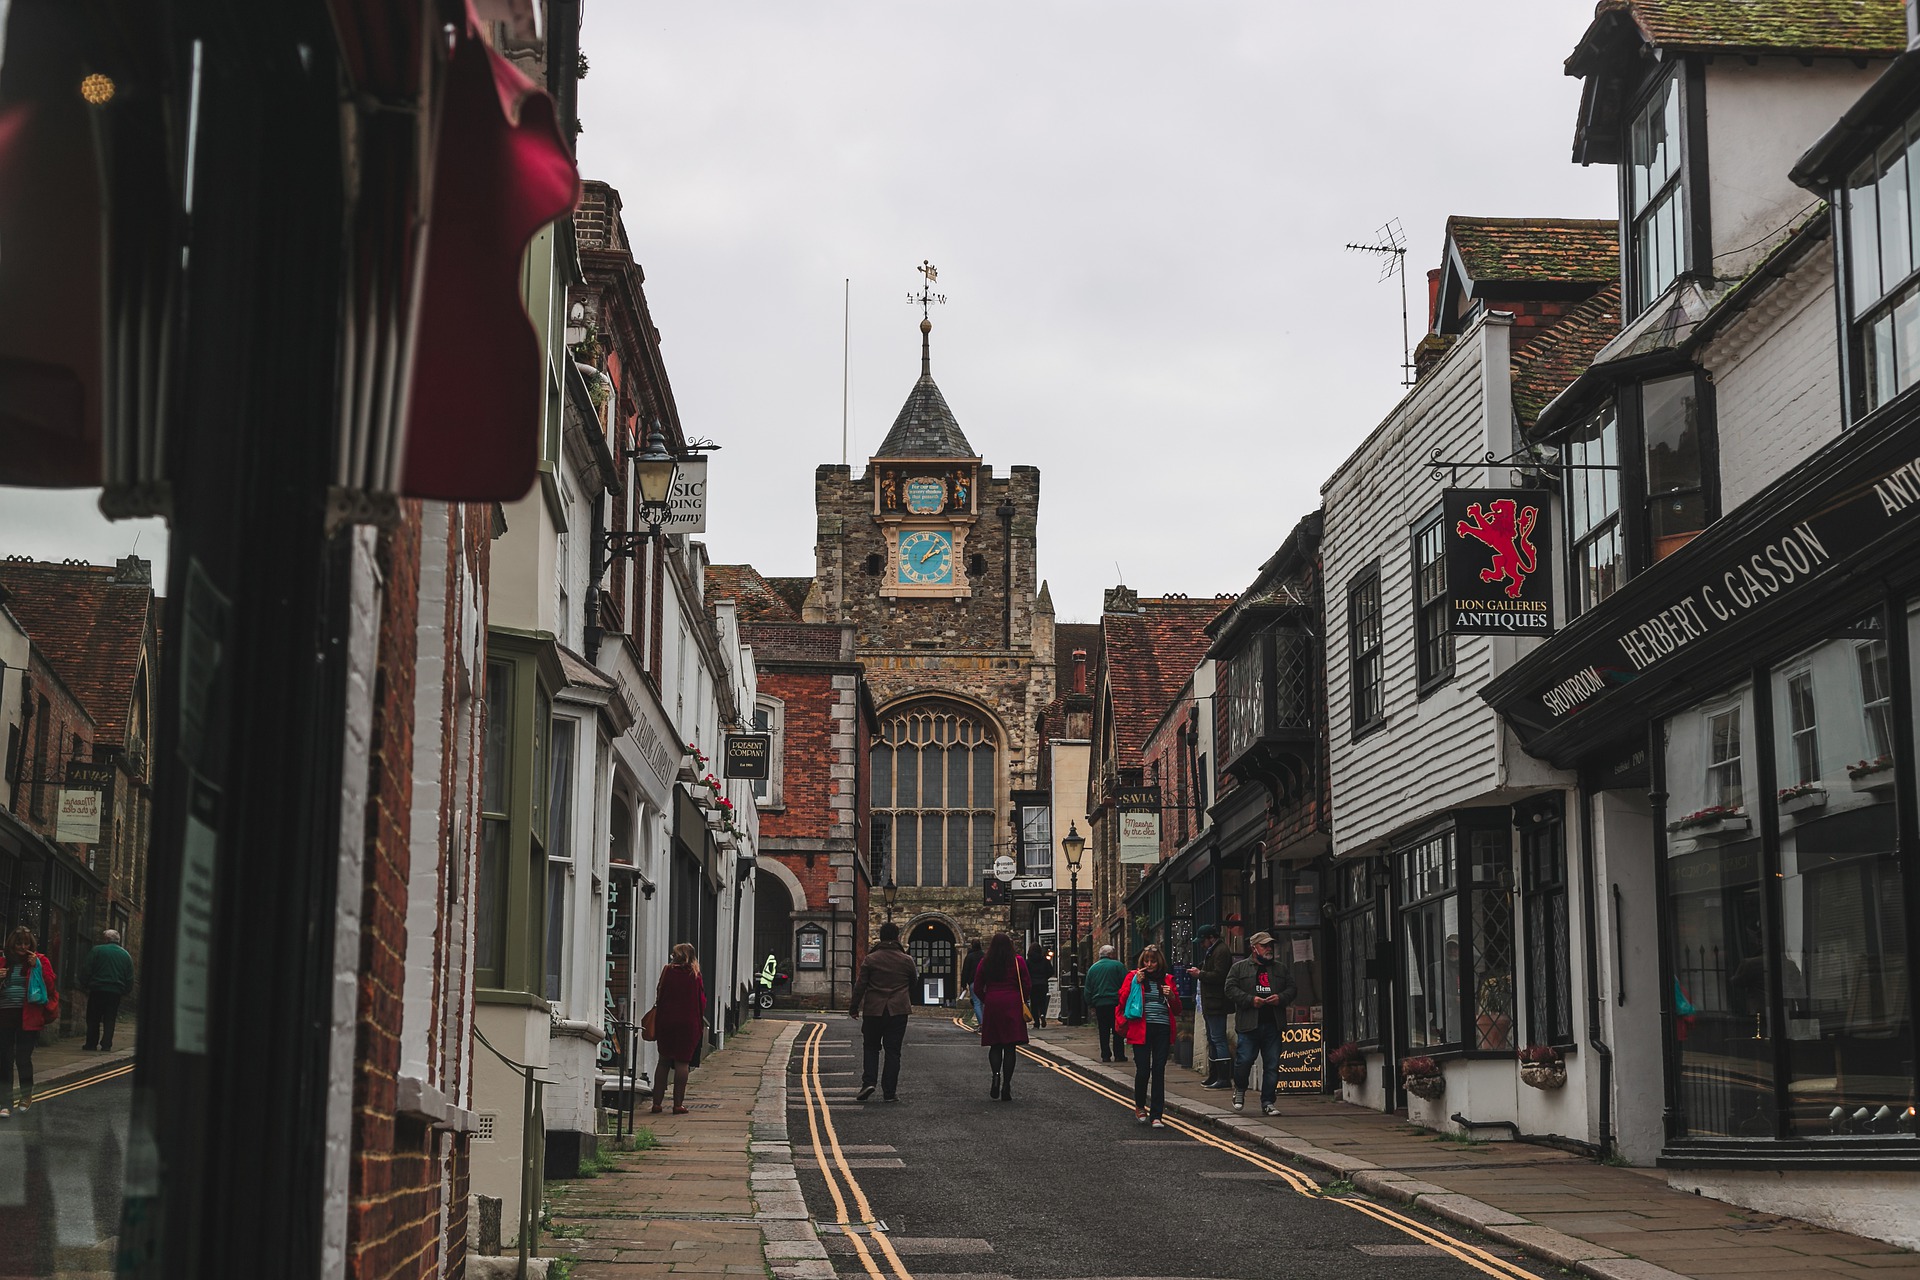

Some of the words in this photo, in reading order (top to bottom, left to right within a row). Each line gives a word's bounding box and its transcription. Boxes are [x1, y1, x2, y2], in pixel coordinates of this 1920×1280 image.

[673, 483, 703, 497] SIC
[670, 499, 702, 509] DING
[1455, 599, 1484, 610] LION
[1487, 600, 1547, 611] GALLERIES
[1455, 612, 1548, 631] ANTIQUES
[1542, 665, 1605, 716] SHOWROOM
[1618, 596, 1709, 670] HERBERT
[1702, 585, 1736, 621] G.
[1724, 521, 1830, 609] GASSON
[732, 741, 763, 750] PRESENT
[729, 749, 765, 757] COMPANY
[1122, 794, 1155, 804] SAVIA
[1021, 880, 1043, 888] Teas
[1278, 1064, 1321, 1073] Secondhand
